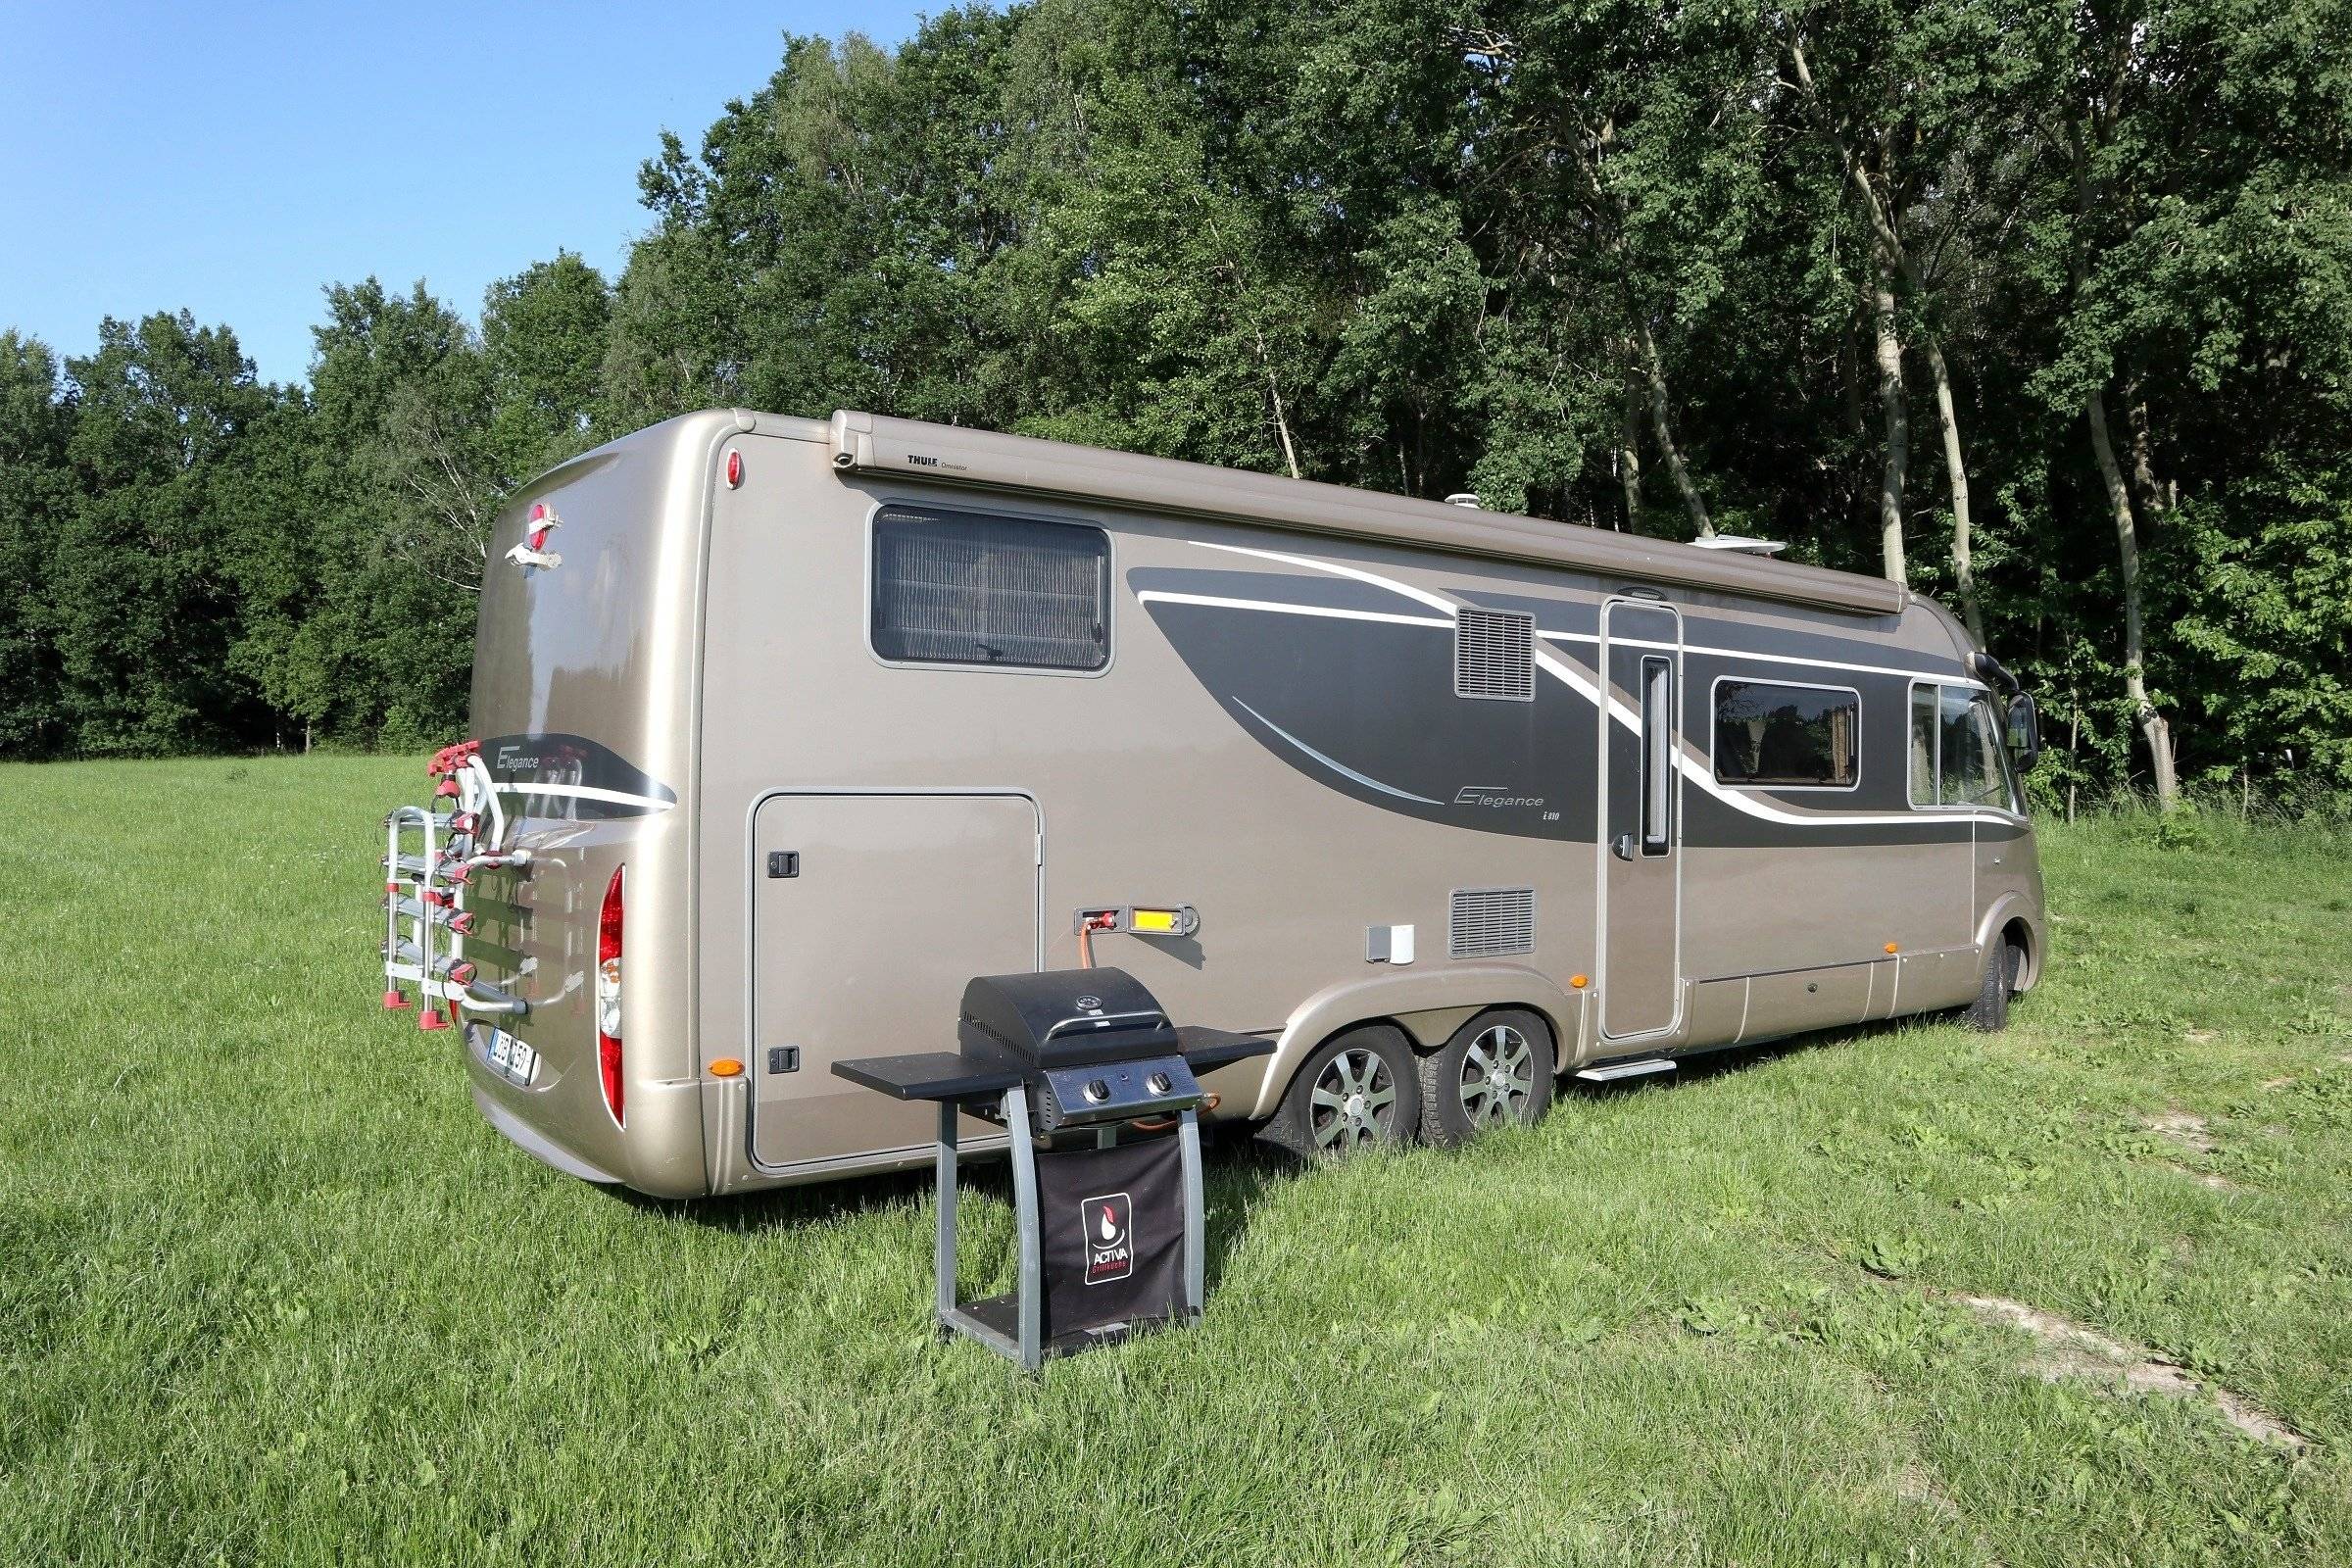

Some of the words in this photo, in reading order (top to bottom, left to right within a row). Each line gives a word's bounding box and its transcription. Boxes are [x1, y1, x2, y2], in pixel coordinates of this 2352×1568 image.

[907, 454, 938, 467] THULE
[941, 462, 968, 471] Omnistor
[496, 745, 540, 772] Elegance
[1453, 786, 1544, 808] Elegance
[1093, 1248, 1128, 1266] ACTIVA
